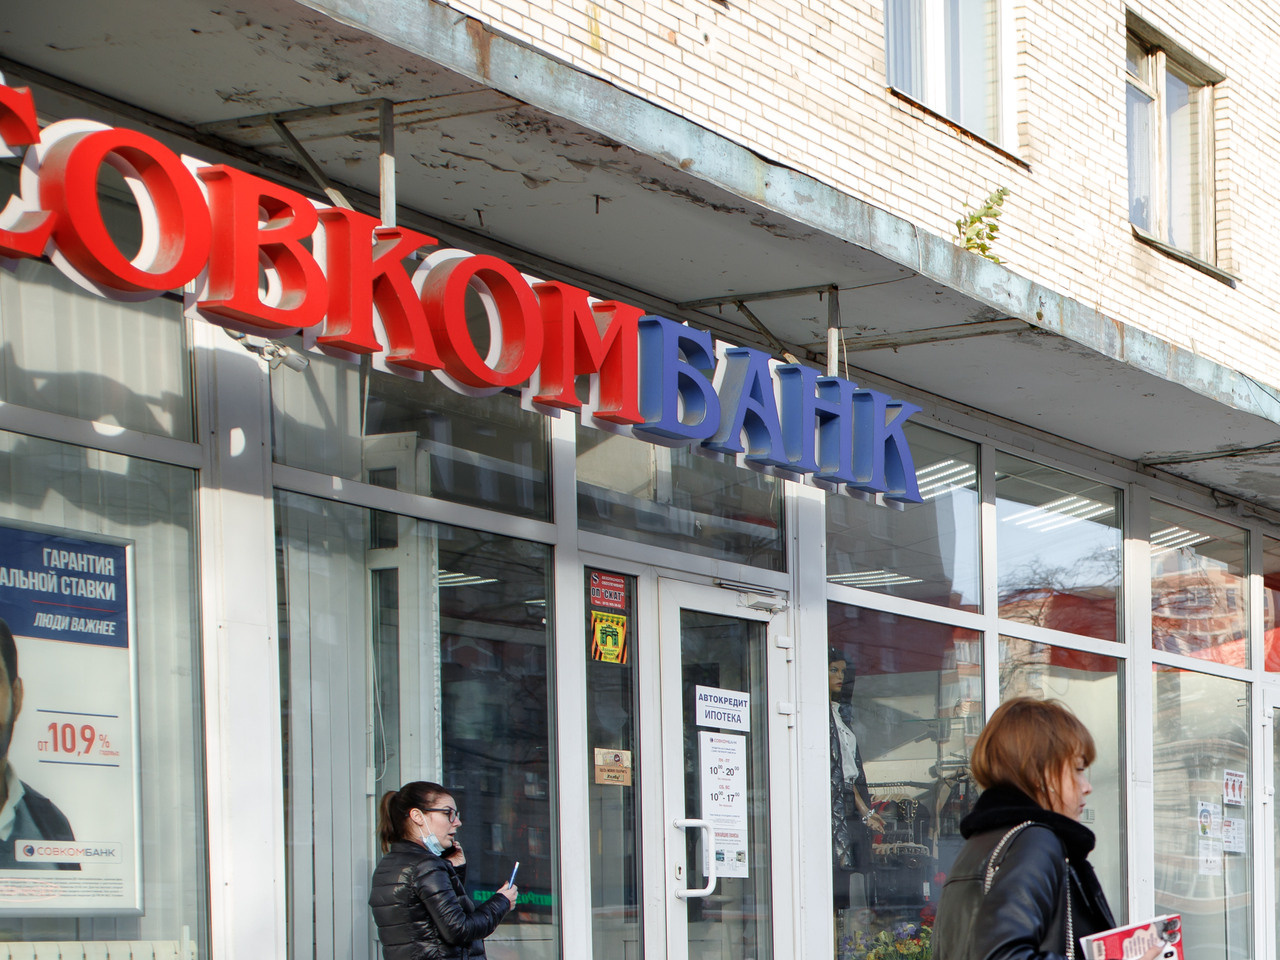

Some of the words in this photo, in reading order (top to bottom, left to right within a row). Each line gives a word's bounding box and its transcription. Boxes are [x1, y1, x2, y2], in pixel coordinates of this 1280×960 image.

[42, 547, 115, 577] ГАРАНТИЯ
[60, 576, 116, 601] СТАВКИ
[33, 612, 70, 631] ЛЮДИ
[70, 617, 117, 636] ВАЖНЕЕ
[698, 693, 748, 708] АВТОКРЕДИТ
[704, 709, 742, 723] ИПОТЕКА
[48, 722, 96, 757] 10,9
[99, 734, 110, 749] %
[37, 846, 116, 857] СОВКОМБАНК
